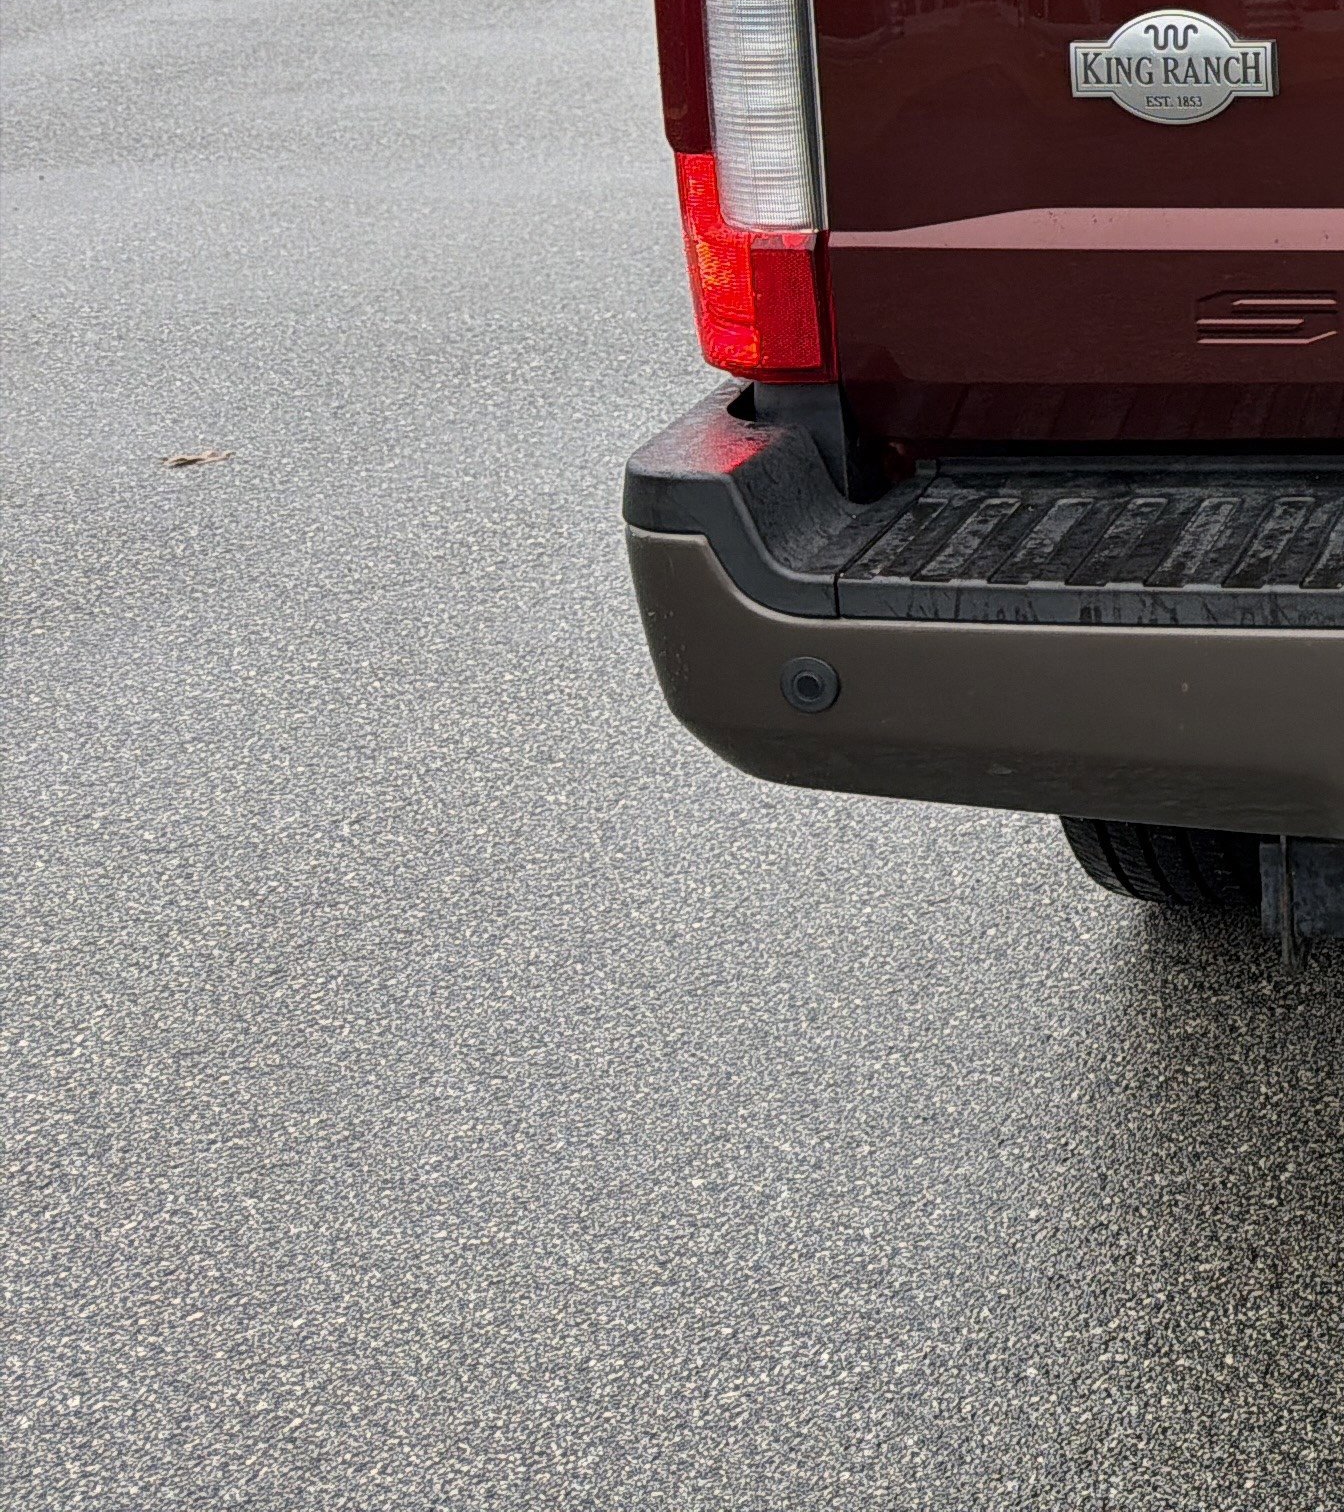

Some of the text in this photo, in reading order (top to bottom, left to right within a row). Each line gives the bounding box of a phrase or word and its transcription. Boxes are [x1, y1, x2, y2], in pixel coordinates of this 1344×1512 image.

[1081, 52, 1262, 85] KING RANCH
[1145, 95, 1203, 108] EST. 1853
